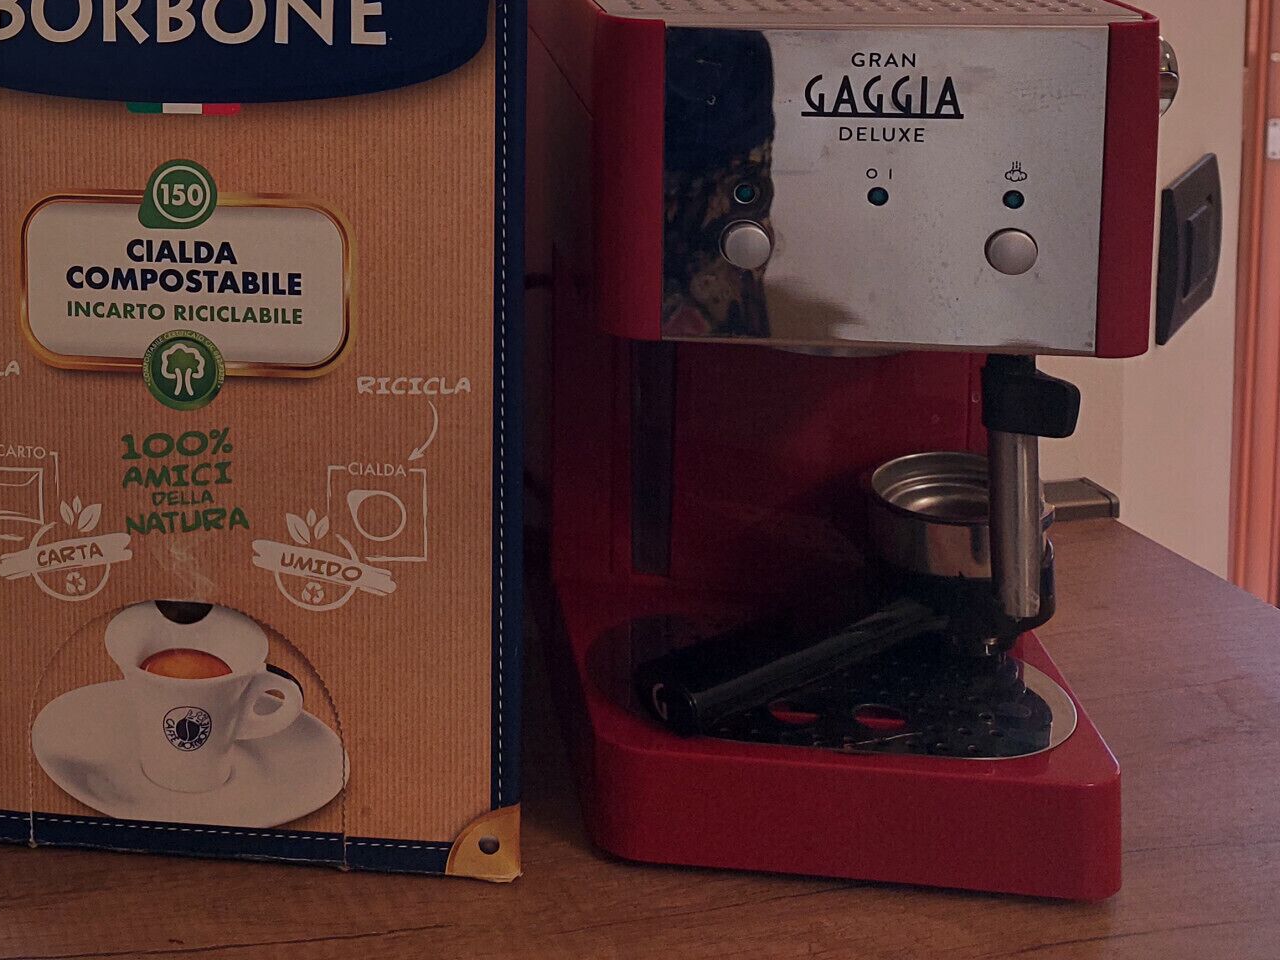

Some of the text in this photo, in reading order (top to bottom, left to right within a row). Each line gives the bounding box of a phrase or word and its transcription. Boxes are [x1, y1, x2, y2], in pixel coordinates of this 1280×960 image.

[851, 52, 917, 68] GRAN
[803, 74, 962, 117] GAGGIA
[838, 126, 926, 143] DELUXE
[160, 183, 204, 207] 150
[126, 238, 238, 265] CIALDA
[65, 266, 303, 296] COMPOSTABILE
[67, 300, 303, 325] INCARTO RICICLABILE
[356, 376, 471, 395] RICICLA
[121, 427, 233, 460] 100%
[122, 461, 233, 489] AMICI
[348, 461, 407, 477] CIALDA
[151, 490, 215, 506] DELLA
[125, 507, 250, 535] NATURA
[36, 542, 104, 567] CARTA
[280, 552, 363, 582] UMIDO
